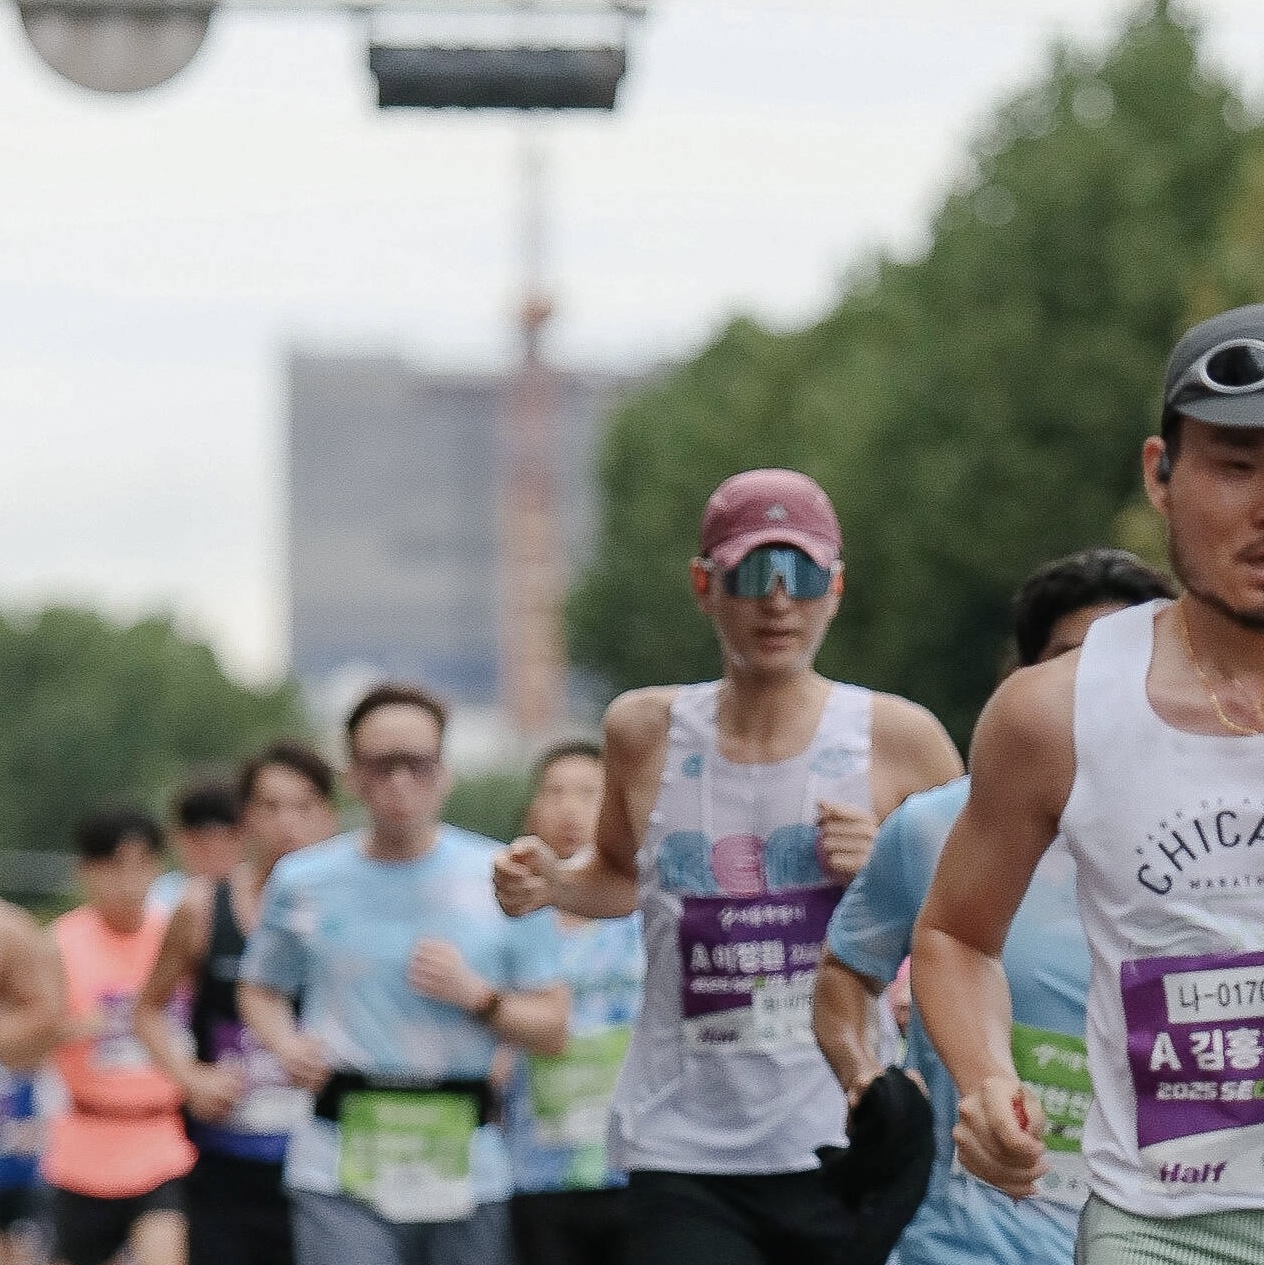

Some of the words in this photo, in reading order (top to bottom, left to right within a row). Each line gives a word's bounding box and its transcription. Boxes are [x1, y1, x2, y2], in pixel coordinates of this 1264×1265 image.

[1149, 1031, 1182, 1073] A
[1156, 1080, 1219, 1101] 2025
[1158, 1160, 1227, 1185] Half
